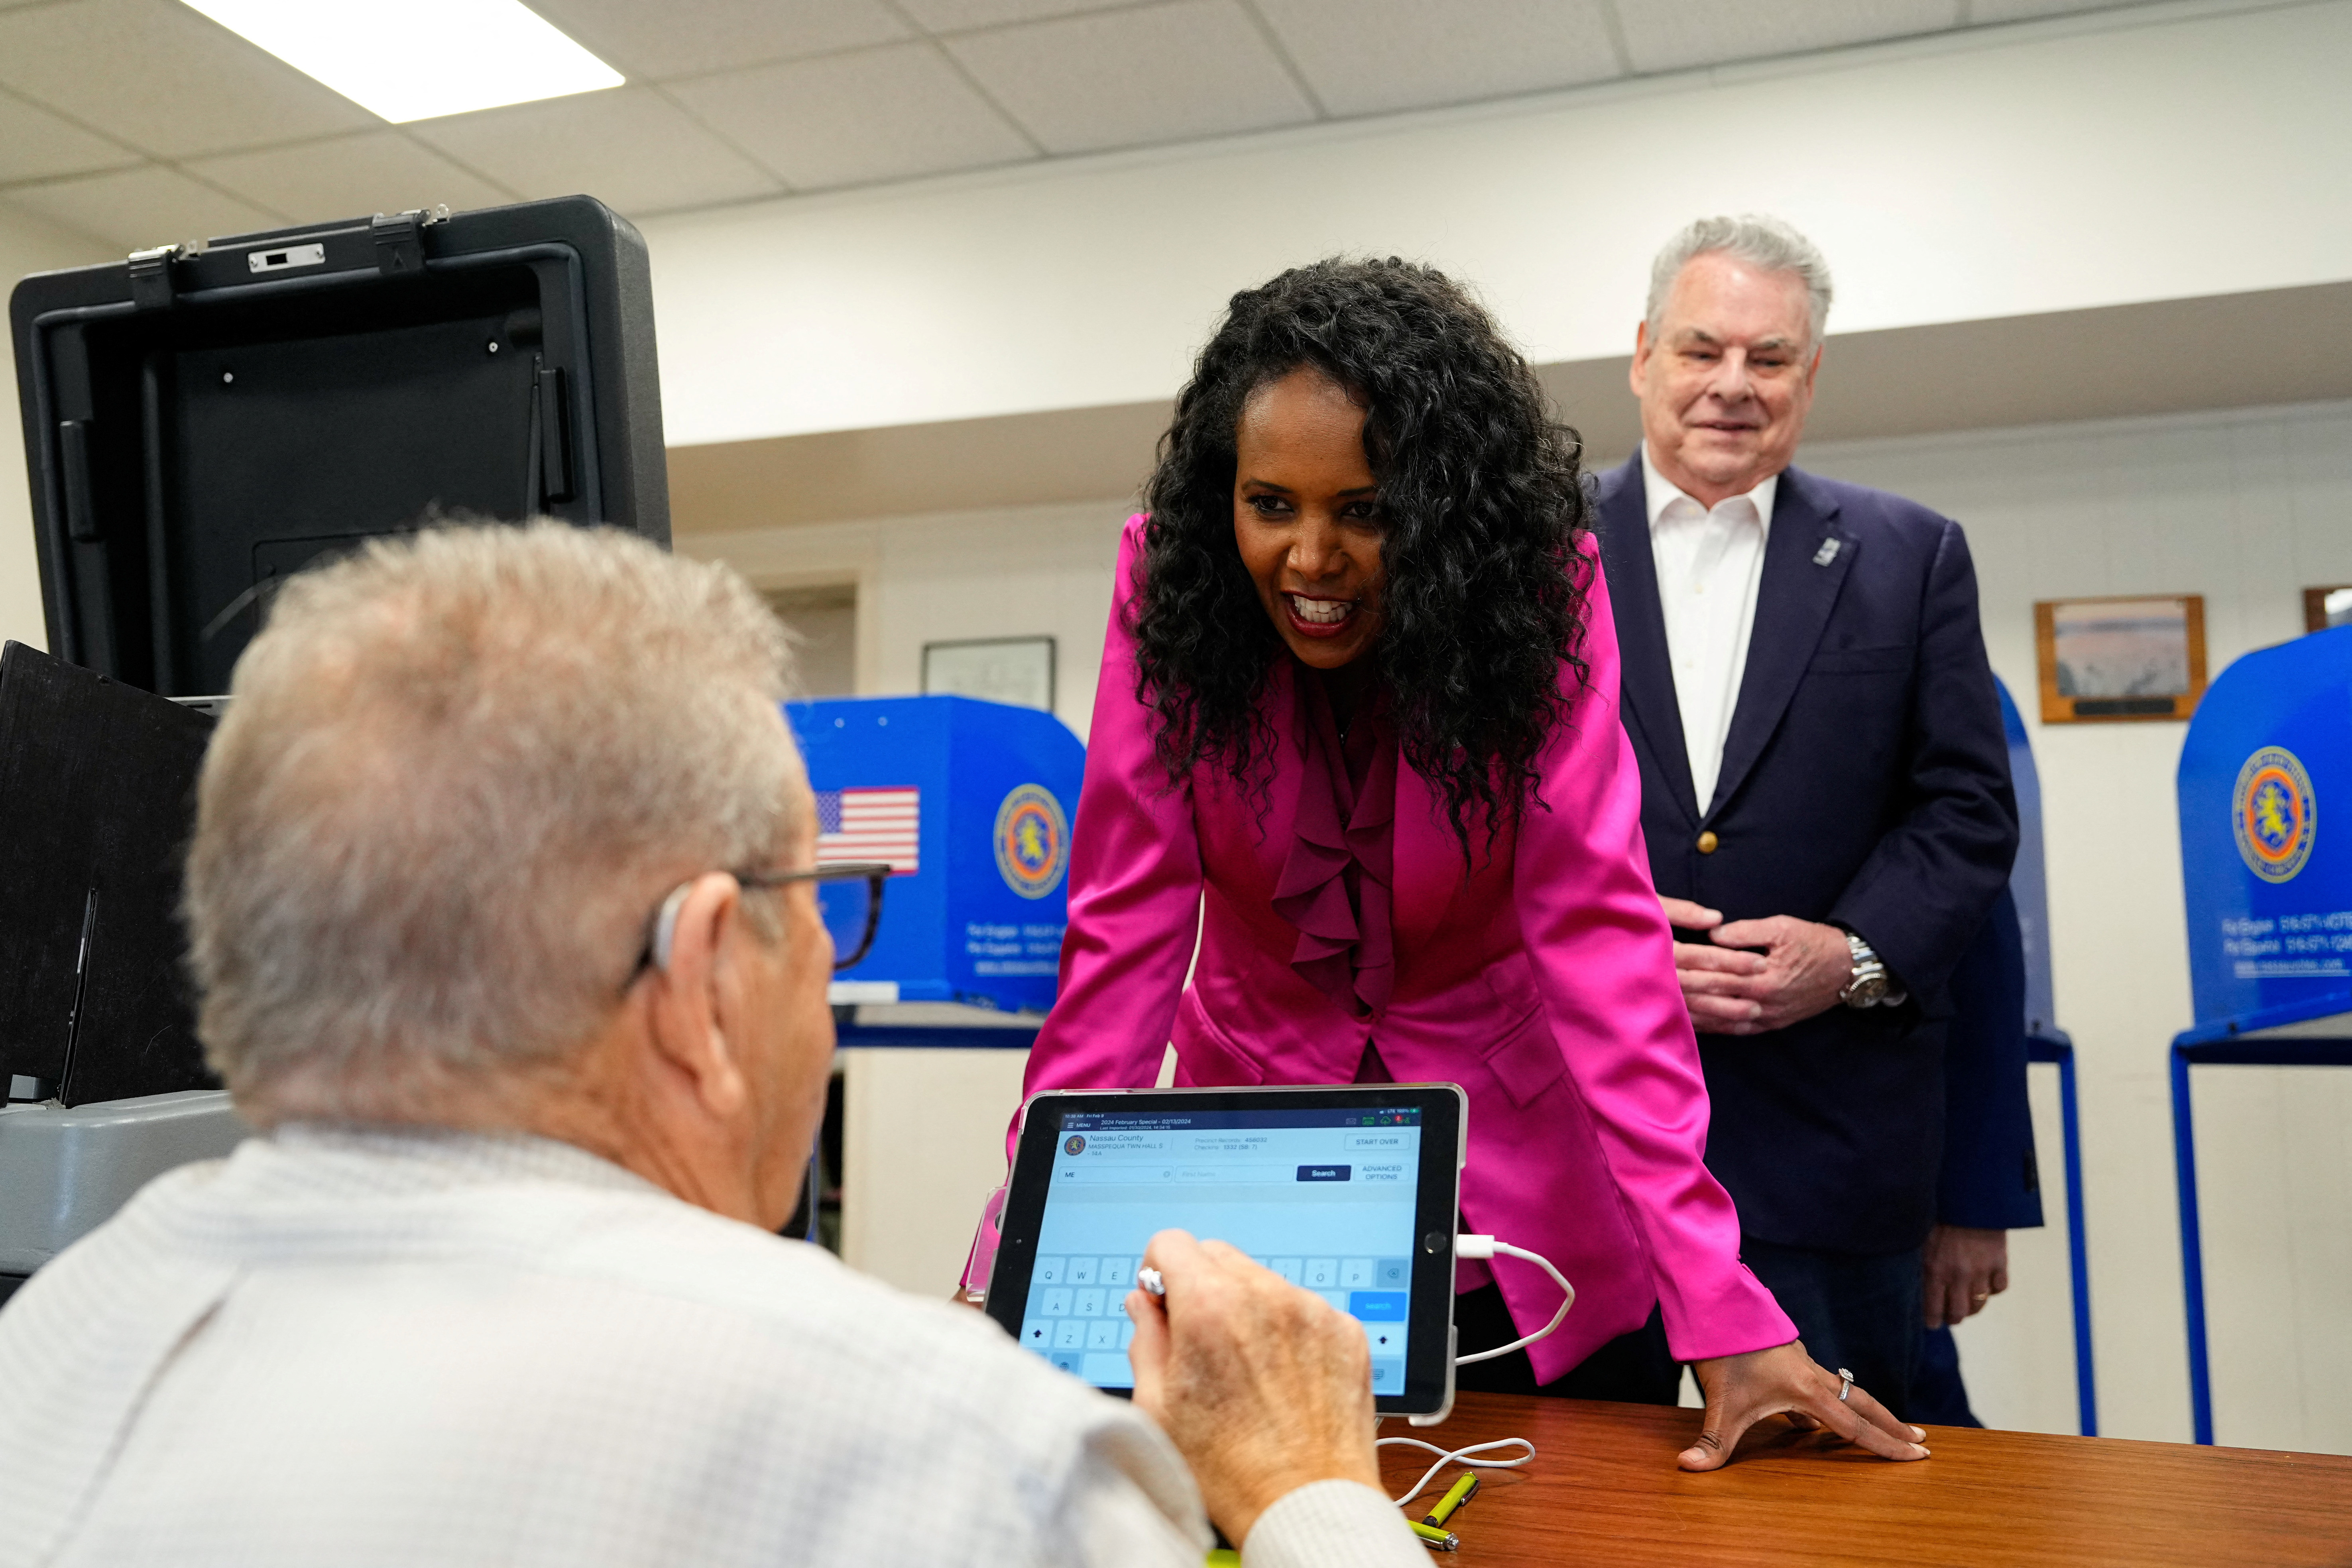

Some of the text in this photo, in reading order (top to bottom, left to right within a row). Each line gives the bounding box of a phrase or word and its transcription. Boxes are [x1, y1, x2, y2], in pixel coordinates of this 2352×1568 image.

[1045, 1271, 1053, 1279] Q
[1316, 1273, 1324, 1281] O
[1086, 1302, 1092, 1311] S
[1119, 1303, 1125, 1312] D
[1066, 1335, 1072, 1344] Z
